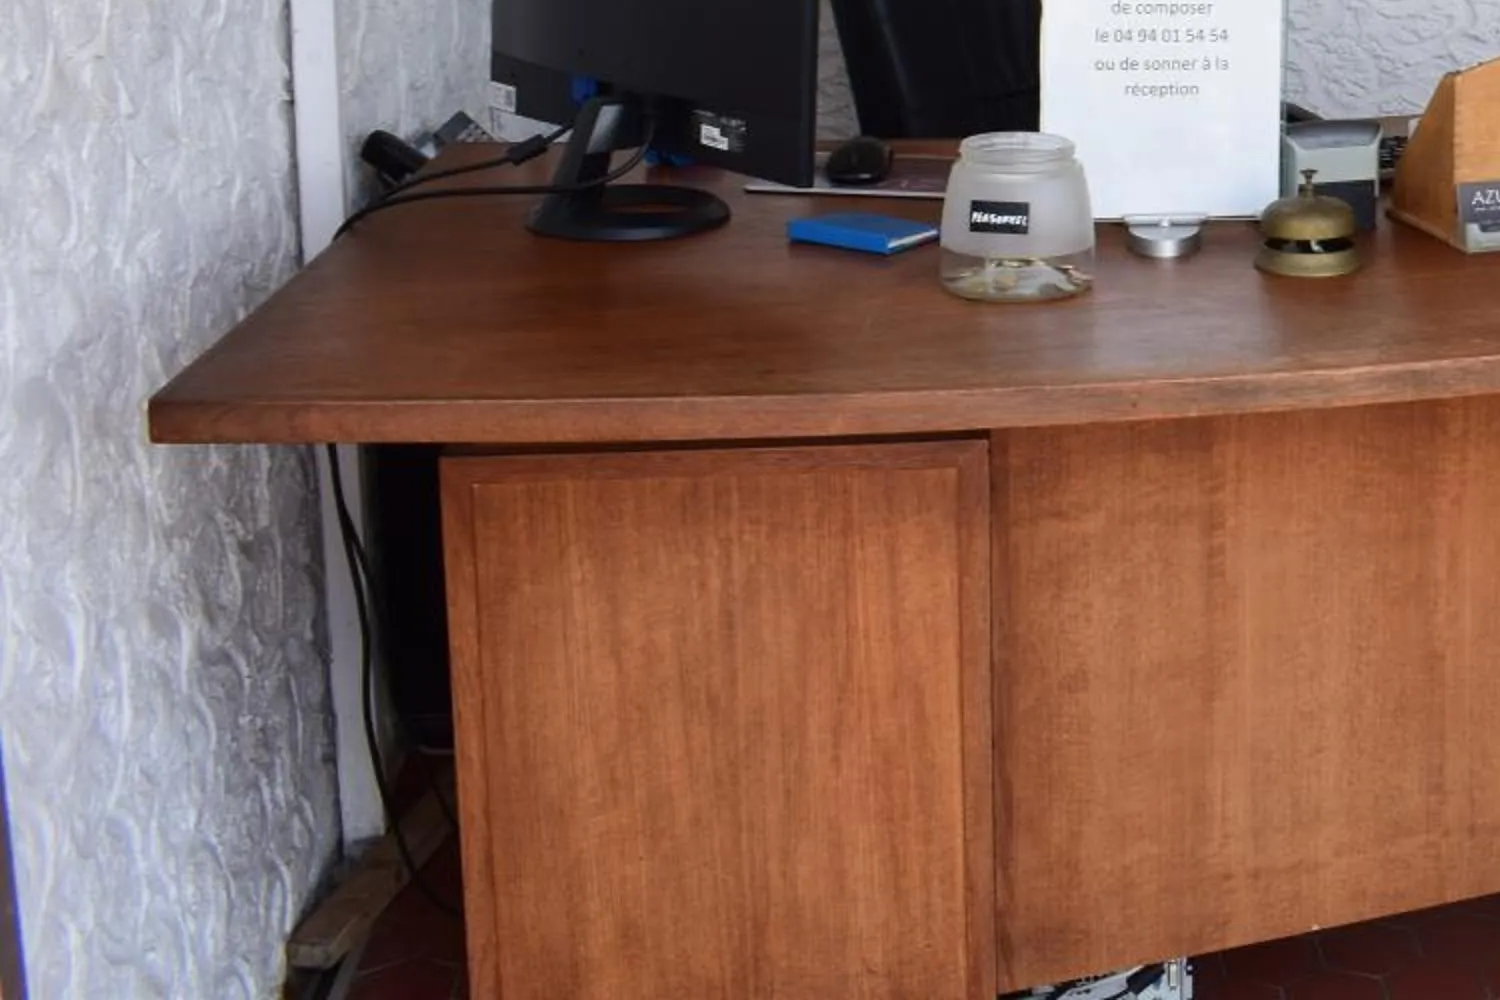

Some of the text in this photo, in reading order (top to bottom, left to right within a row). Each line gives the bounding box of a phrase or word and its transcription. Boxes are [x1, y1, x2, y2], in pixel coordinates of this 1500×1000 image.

[1110, 0, 1213, 18] de composer
[1094, 28, 1229, 43] le 04 94 01 54 54
[1094, 56, 1230, 72] ou de sonner à la
[1124, 83, 1200, 98] réception
